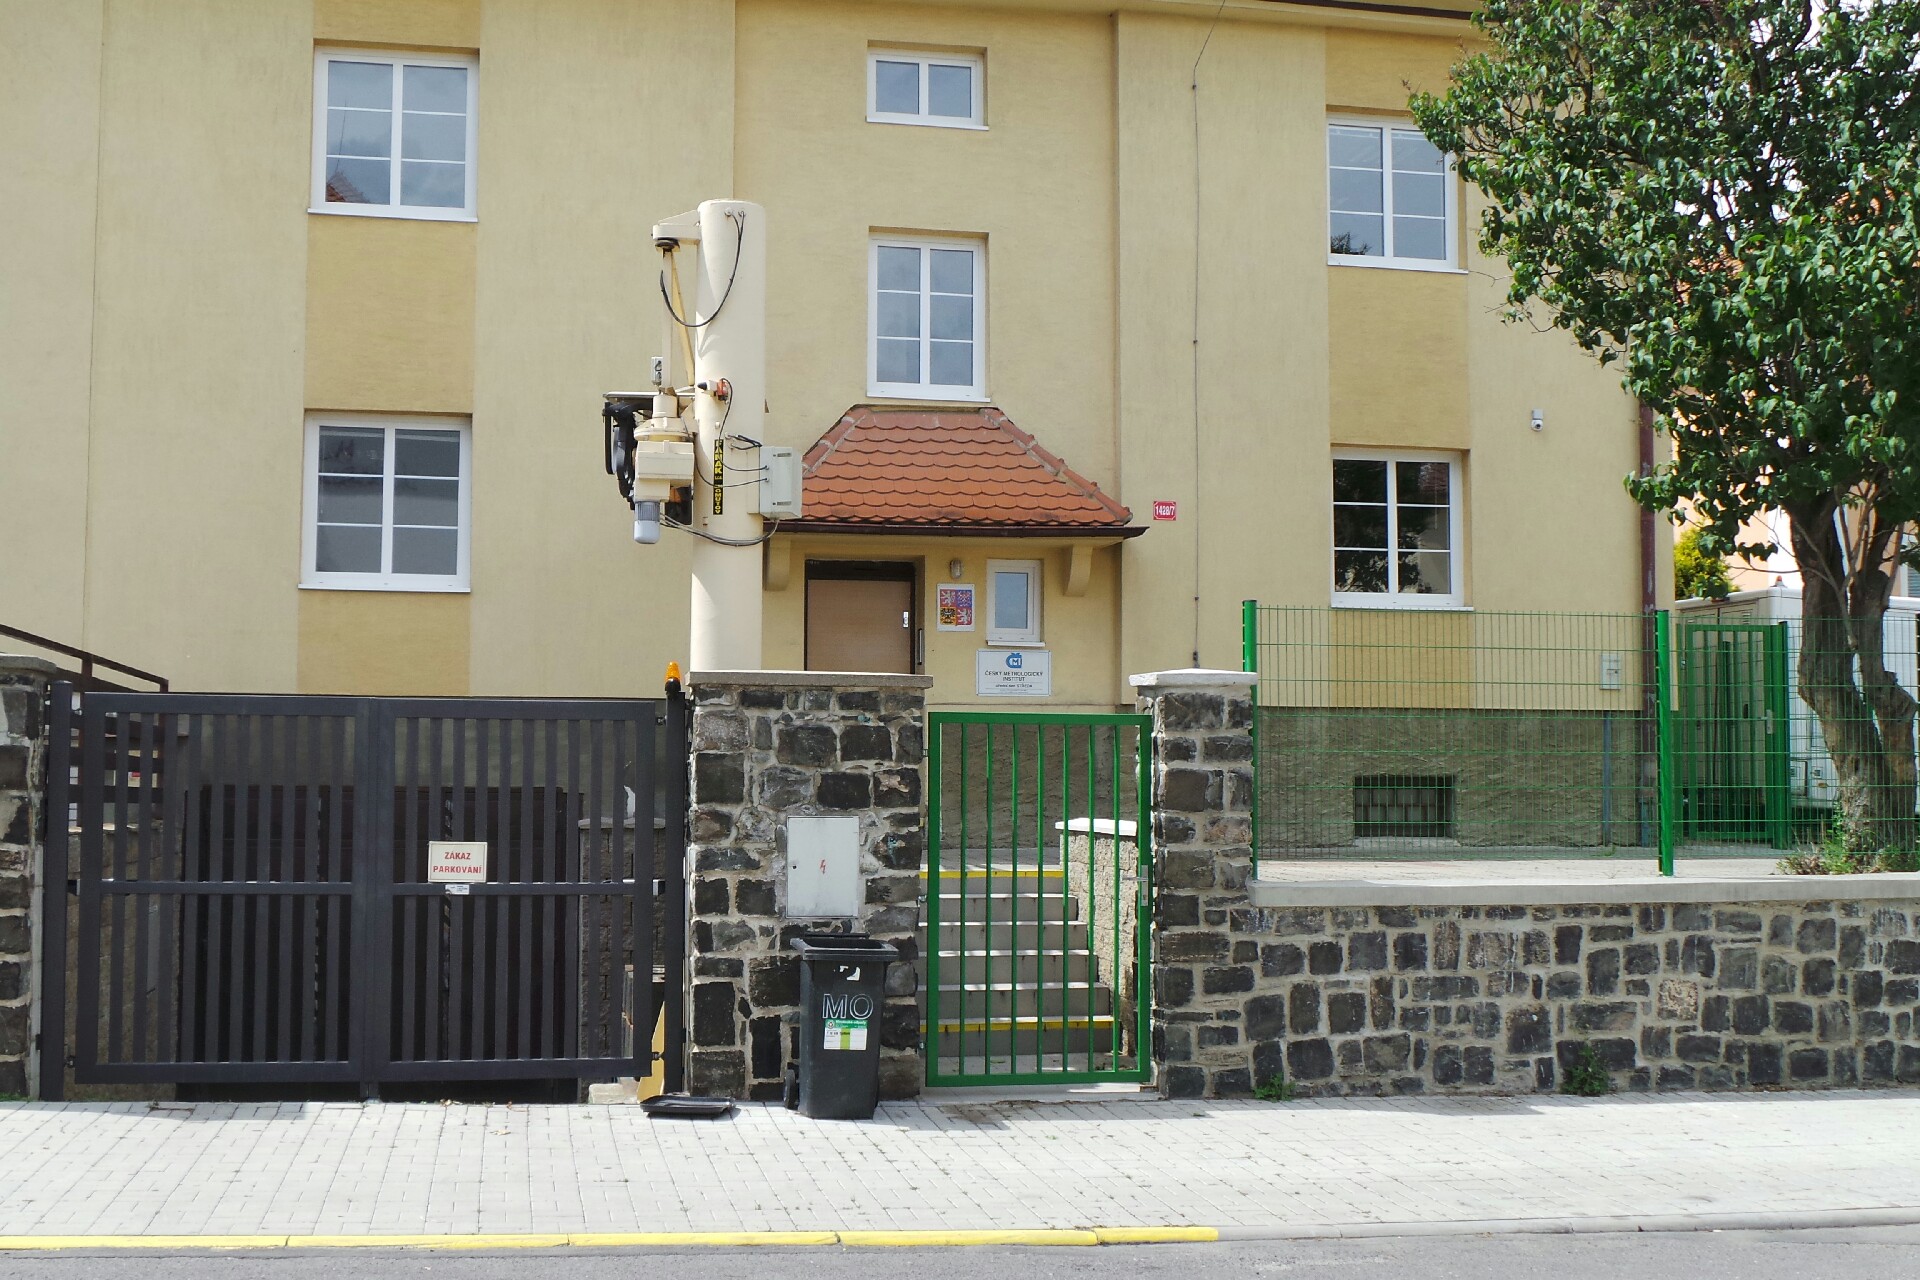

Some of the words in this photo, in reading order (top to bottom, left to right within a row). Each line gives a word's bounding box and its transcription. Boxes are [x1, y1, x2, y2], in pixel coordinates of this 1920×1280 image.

[444, 850, 471, 860] ZÁKAZ
[433, 864, 482, 874] PARKOVÁNÍ
[822, 993, 874, 1020] MO
